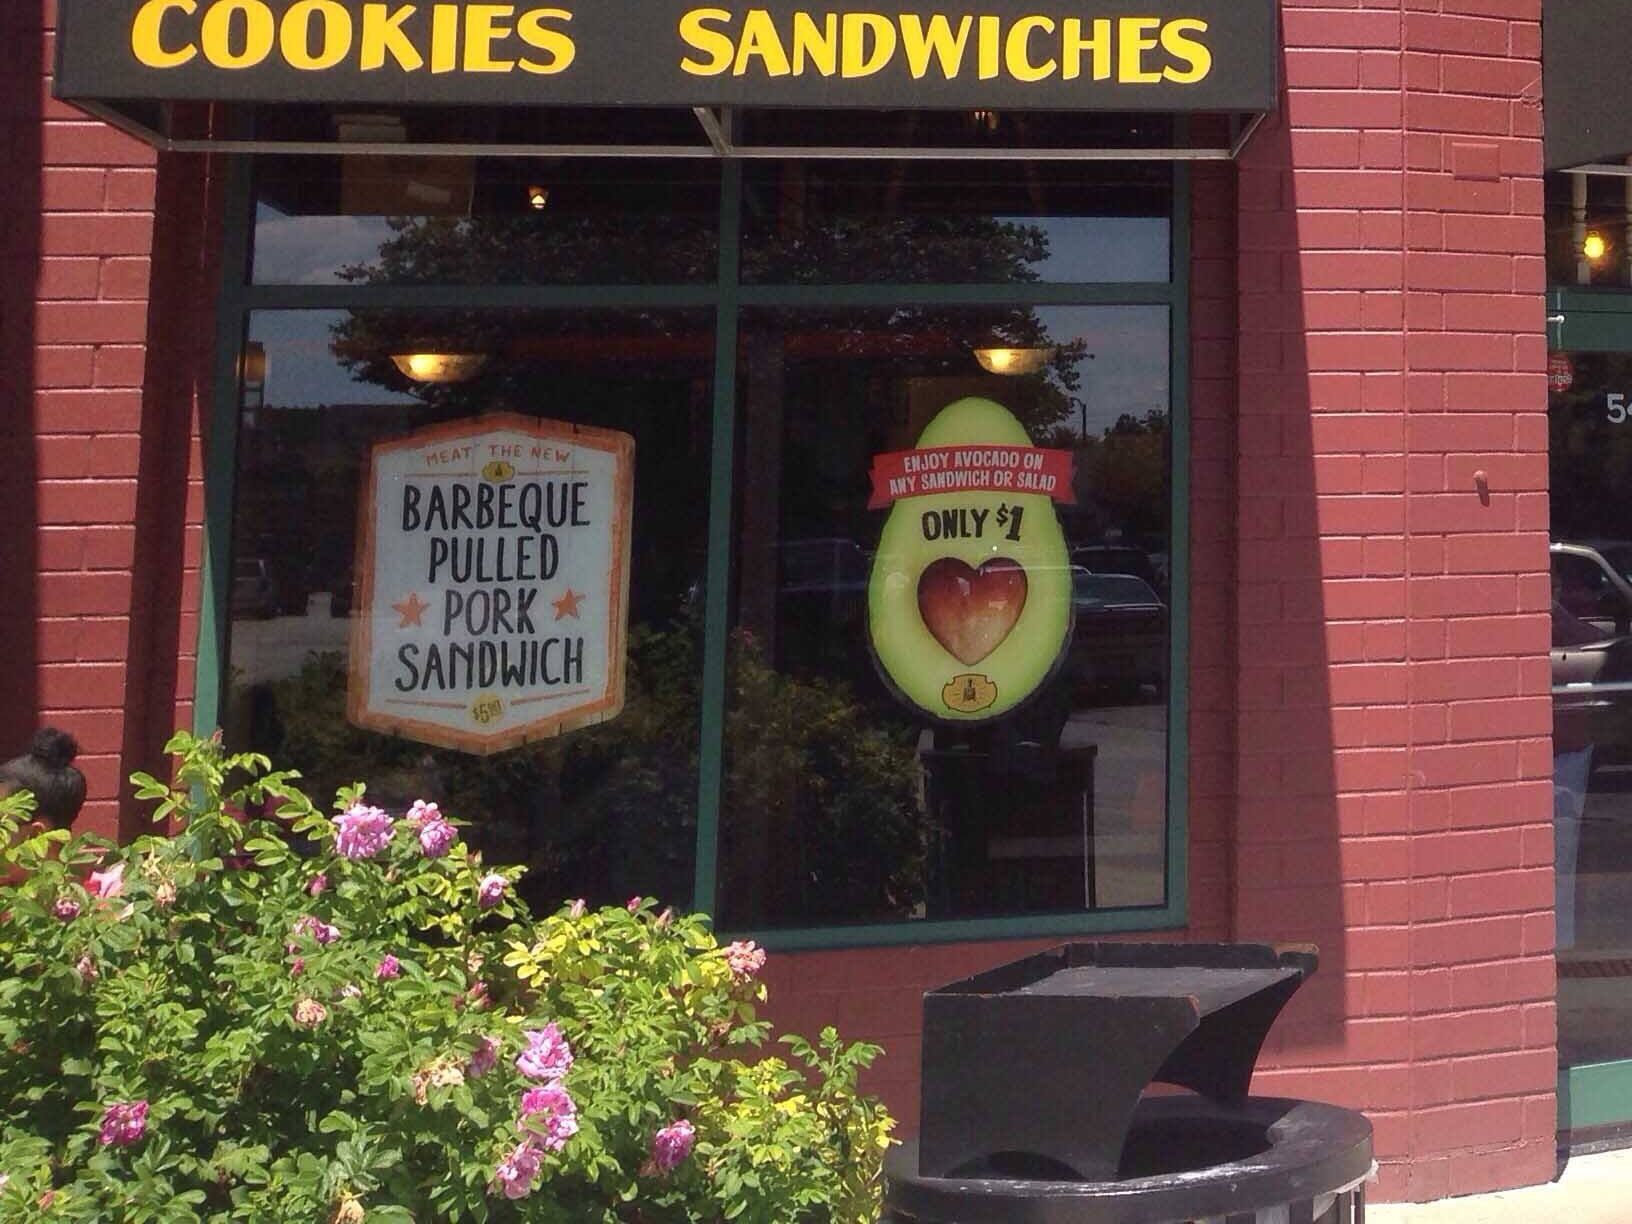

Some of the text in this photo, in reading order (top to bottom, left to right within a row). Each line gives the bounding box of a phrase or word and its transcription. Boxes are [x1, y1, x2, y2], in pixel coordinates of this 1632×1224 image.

[679, 8, 1212, 84] SANDWICHES
[426, 444, 571, 466] MEAT THE NEW
[904, 450, 1044, 473] ENJOY AVOCADO ON
[402, 481, 591, 532] BARBEQUE
[889, 470, 1056, 496] ANY SANDWICH OR SALAD
[921, 502, 1024, 541] ONLY $1
[428, 534, 560, 583] PULLED
[444, 588, 537, 636] PORK
[395, 637, 585, 692] SANDWICH
